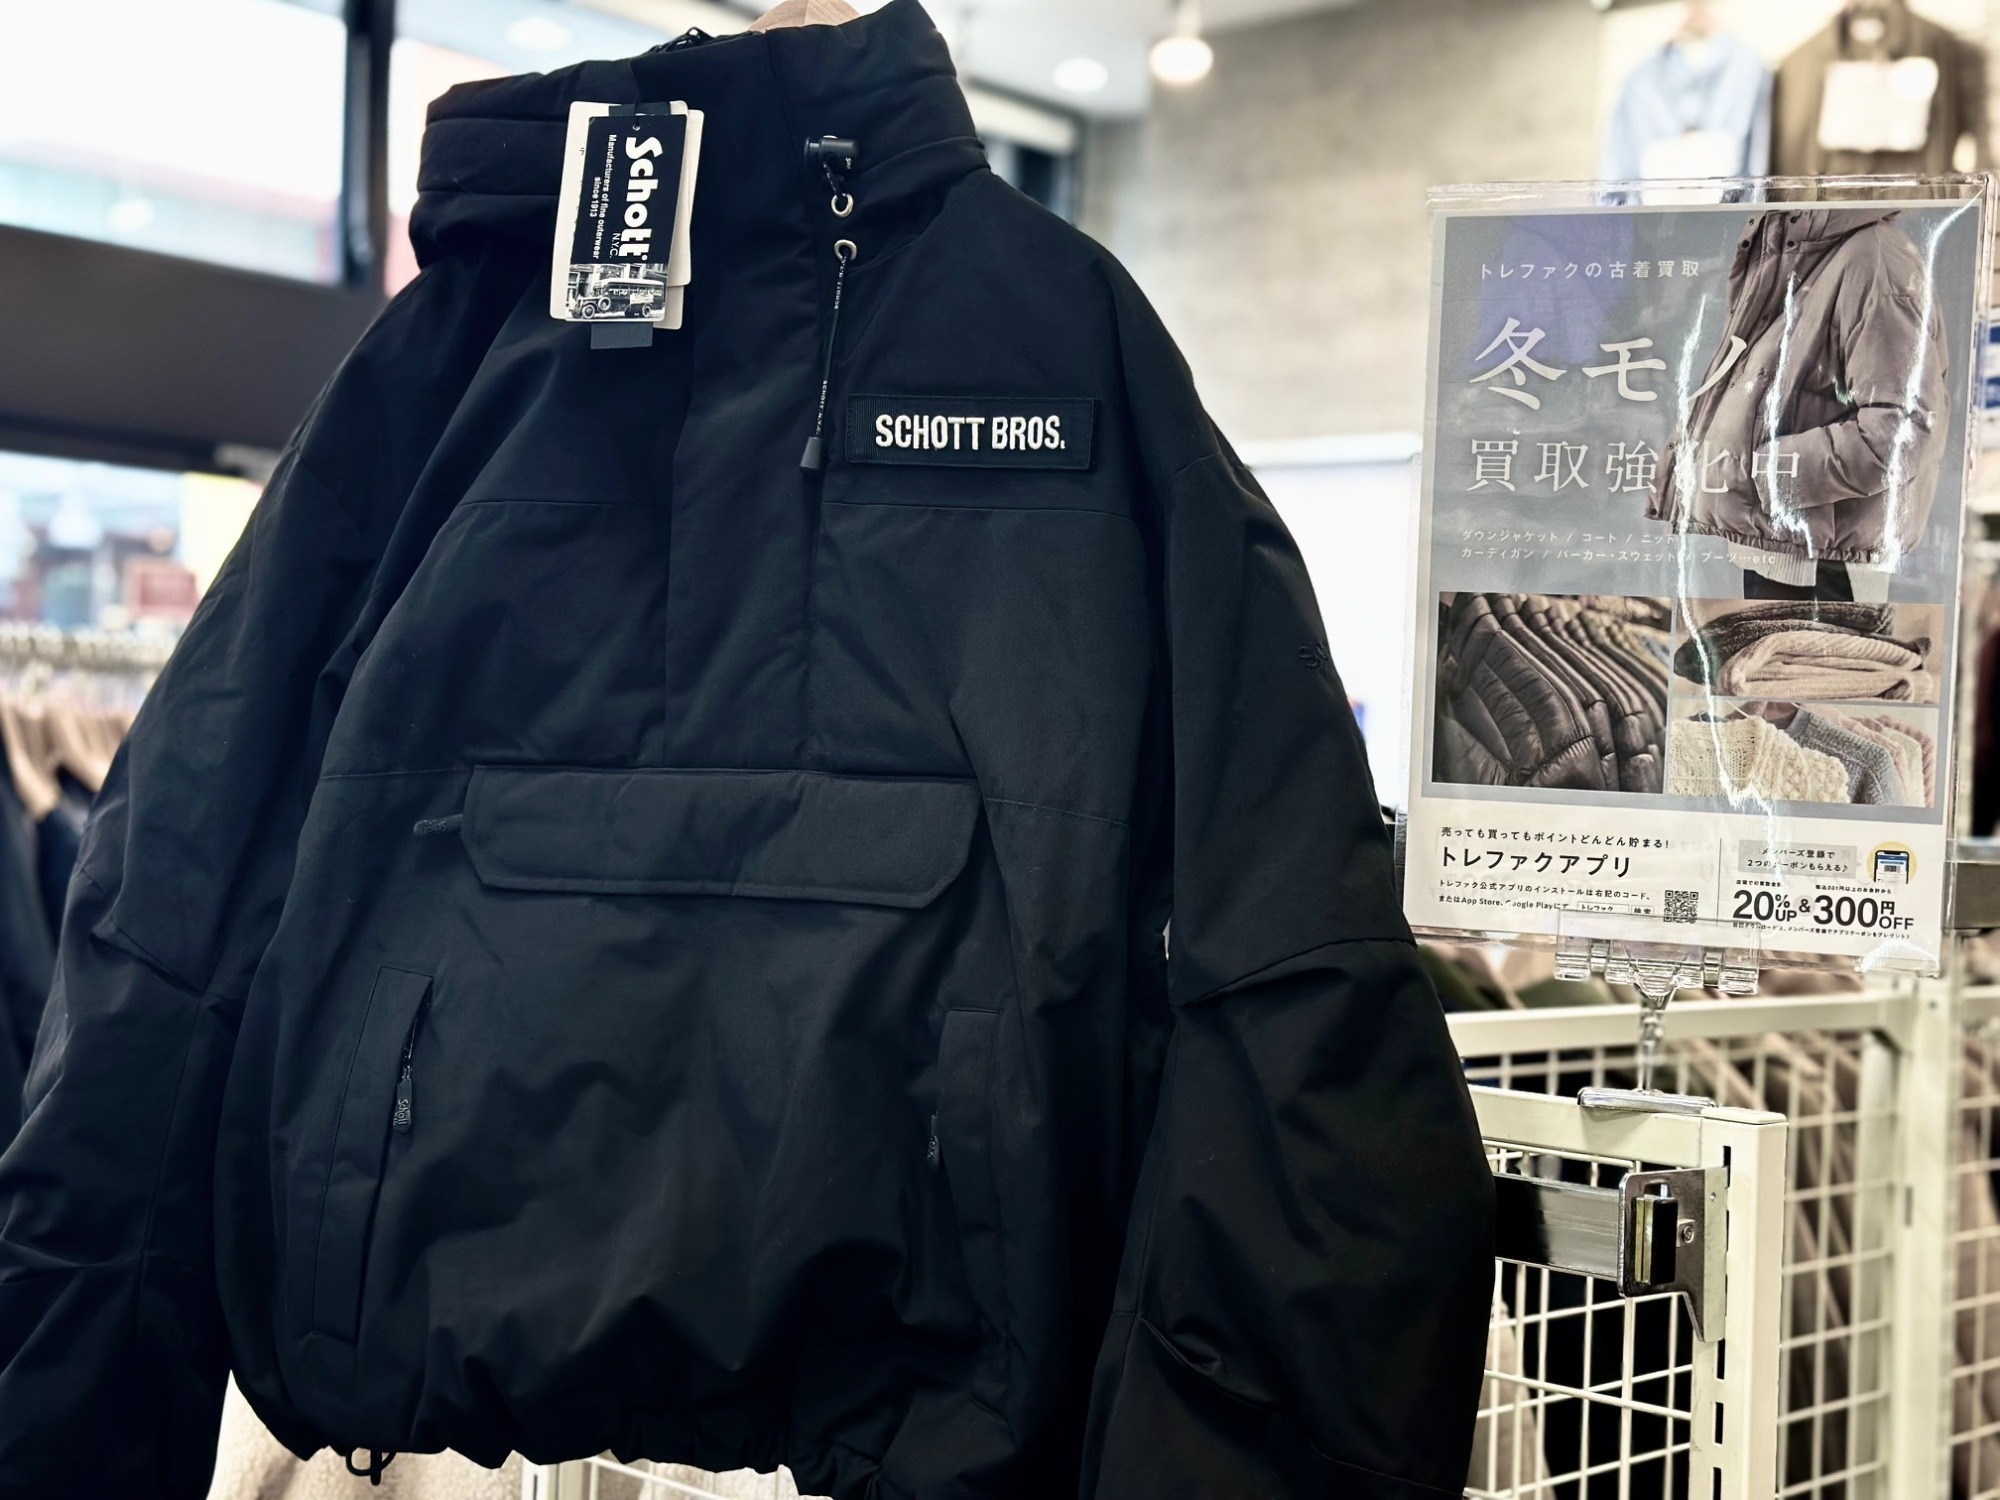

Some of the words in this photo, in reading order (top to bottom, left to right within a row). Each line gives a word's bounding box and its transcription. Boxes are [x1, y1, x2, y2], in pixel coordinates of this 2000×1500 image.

[602, 134, 618, 192] Manufacturers
[592, 176, 601, 198] since
[601, 193, 609, 202] of
[618, 136, 663, 257] Schott
[589, 200, 598, 217] 1913
[598, 203, 609, 218] fine
[592, 219, 605, 259] outerwear
[609, 232, 621, 259] N.Y.C.
[1481, 260, 1700, 280] トレファクの古着買取
[1469, 317, 1748, 411] 冬モノ
[875, 414, 985, 451] SCHOTT
[991, 414, 1066, 451] BROS.
[1462, 530, 1558, 542] ダウンジャケット
[1582, 532, 1617, 544] コート
[1461, 547, 1534, 560] カーディガン
[1443, 846, 1630, 878] トレファクアプリ
[1775, 909, 1797, 922] UP
[1879, 916, 1915, 930] OFF
